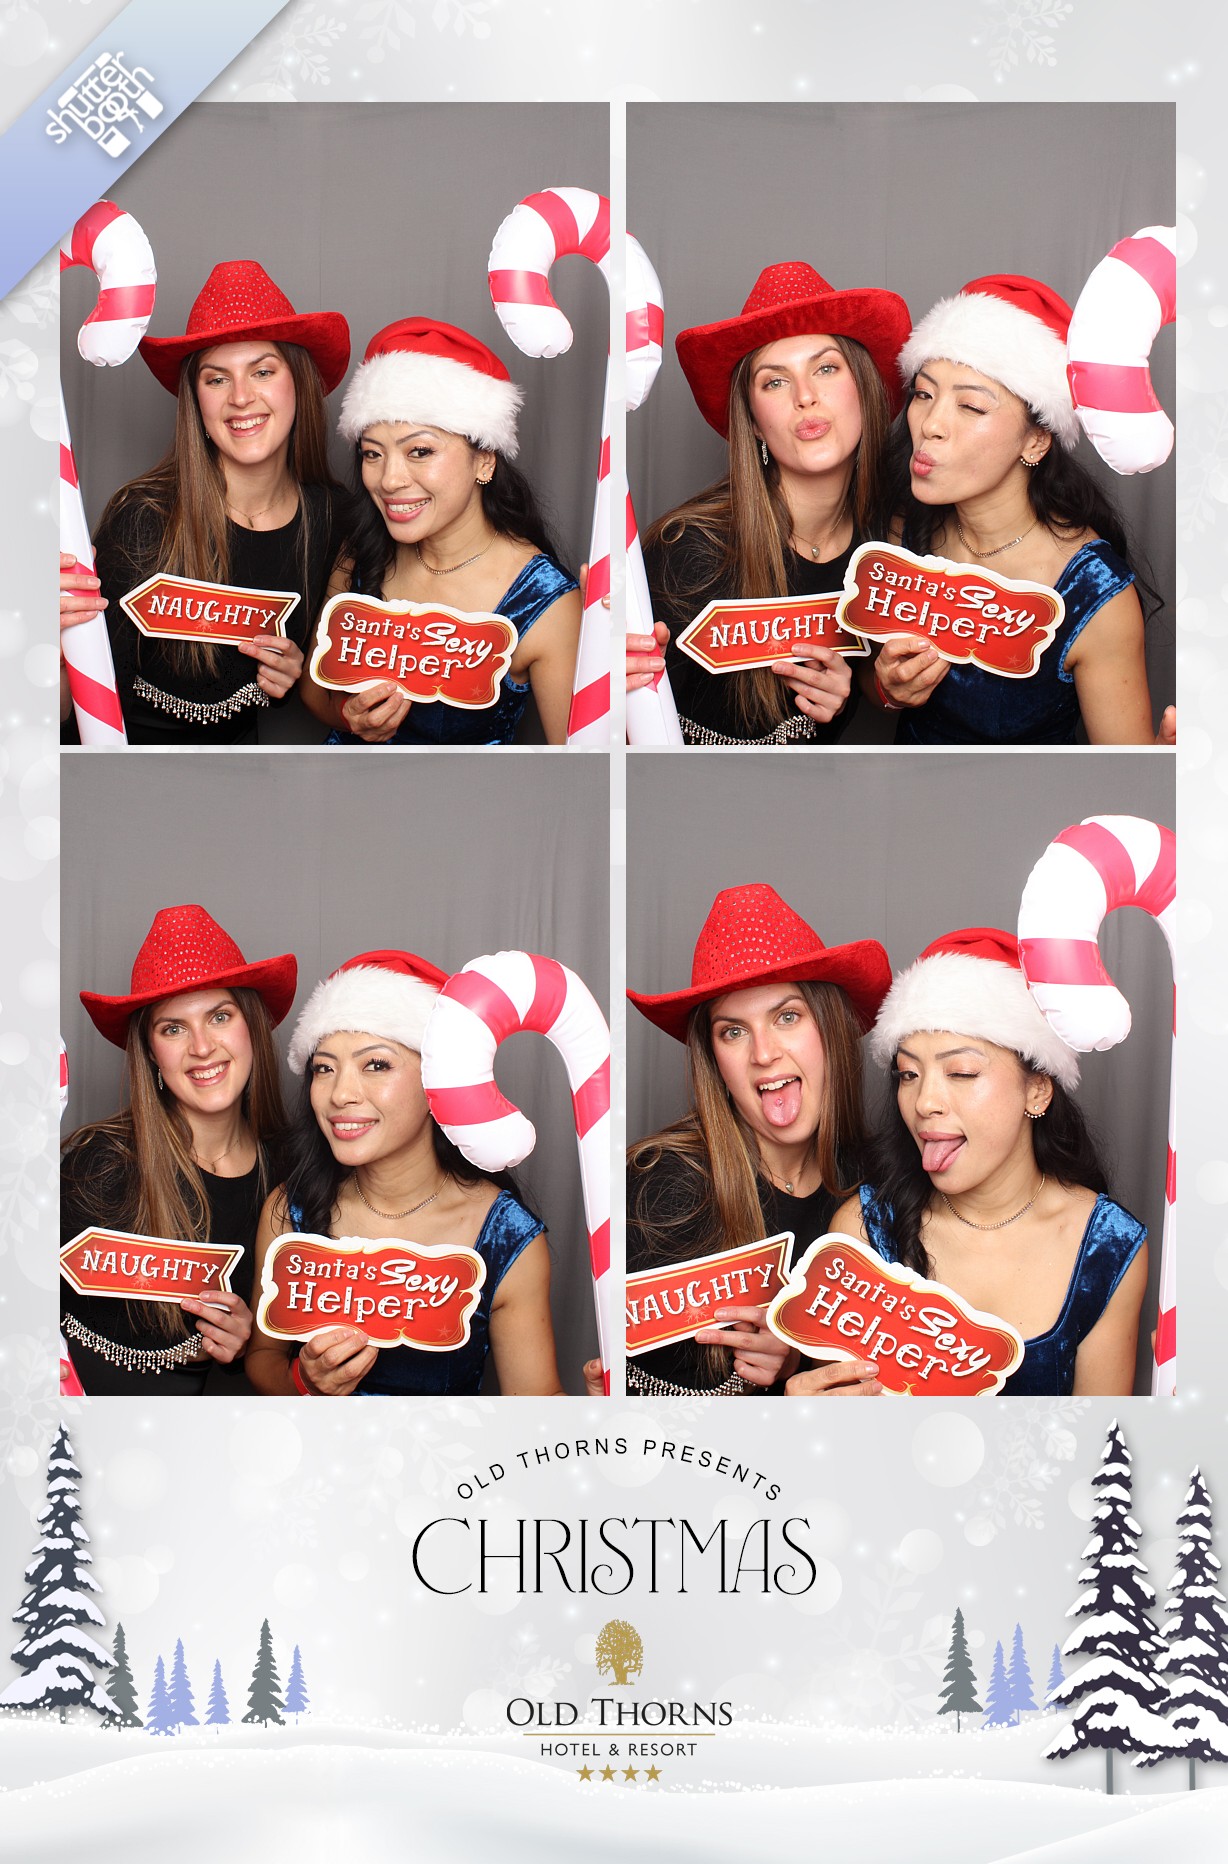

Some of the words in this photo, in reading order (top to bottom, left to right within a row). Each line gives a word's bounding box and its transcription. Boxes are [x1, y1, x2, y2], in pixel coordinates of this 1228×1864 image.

[147, 595, 276, 630] NAUGHTY
[864, 586, 1002, 645] Helper
[868, 562, 957, 602] Santa's
[956, 585, 1036, 637] Sexy
[338, 637, 465, 680] Helper
[340, 612, 421, 641] Santa's
[421, 623, 493, 669] Sexy
[80, 1250, 220, 1284] NAUGHTY
[286, 1254, 378, 1281] Santa's
[379, 1259, 461, 1307] Sexy
[626, 1263, 775, 1327] NAUGHTY
[286, 1281, 429, 1323] Helper
[824, 1257, 917, 1321] Santa's
[907, 1306, 992, 1377] Sexy
[804, 1284, 949, 1380] Helper
